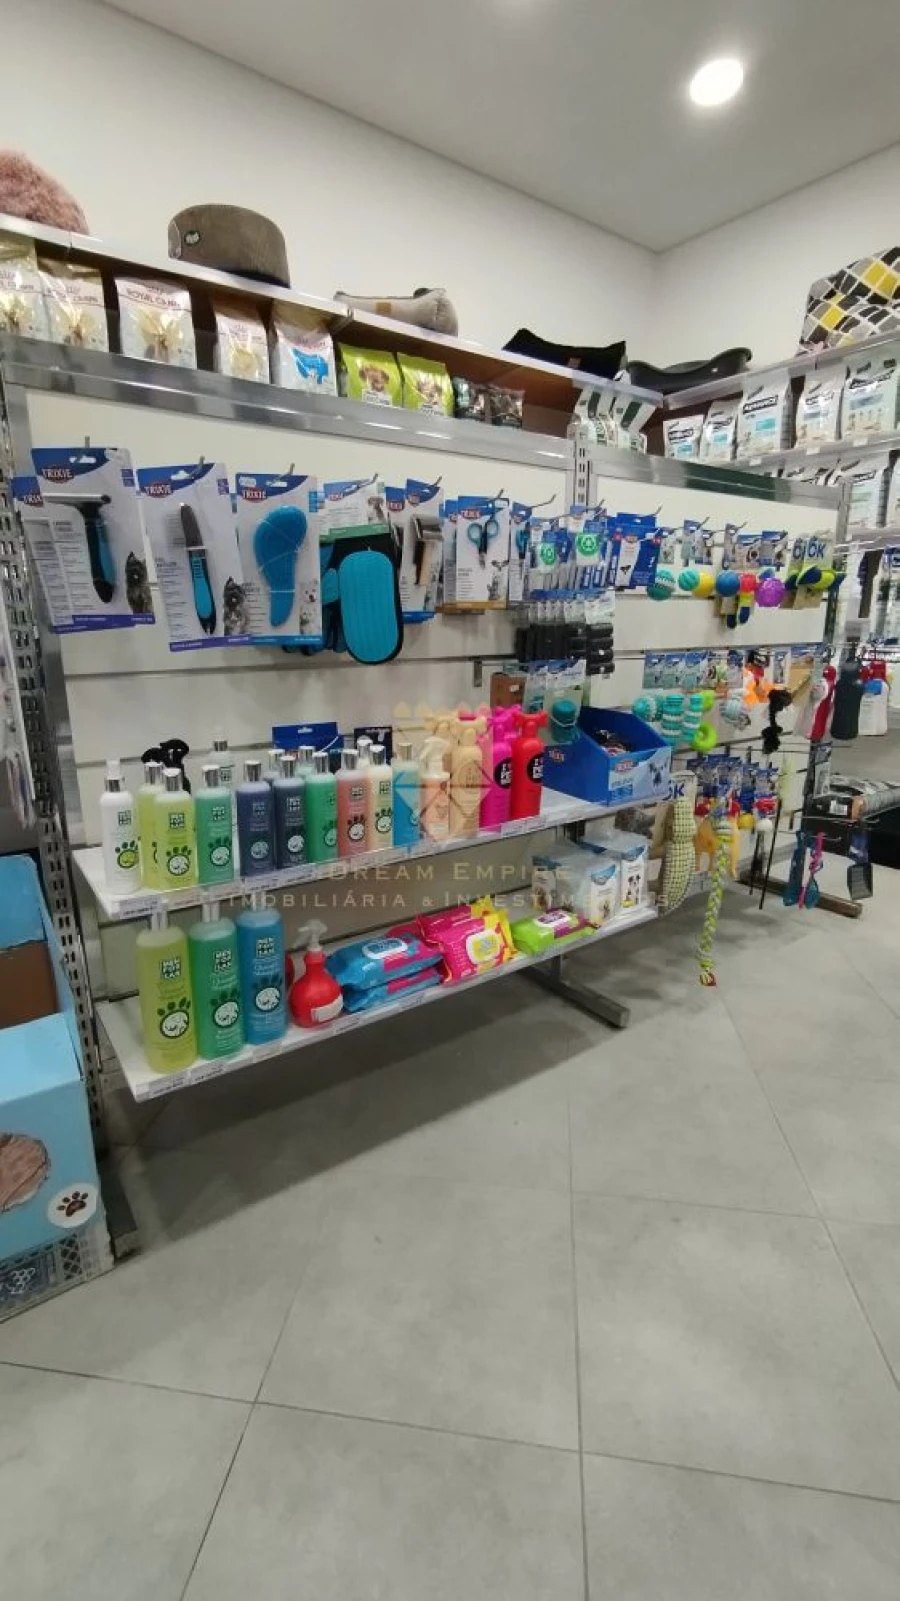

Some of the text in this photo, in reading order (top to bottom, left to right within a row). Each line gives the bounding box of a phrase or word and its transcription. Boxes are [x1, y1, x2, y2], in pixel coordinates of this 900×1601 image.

[42, 468, 73, 479] TRIXIE
[144, 484, 171, 494] TRIXIE
[241, 489, 267, 499] TRIXIE
